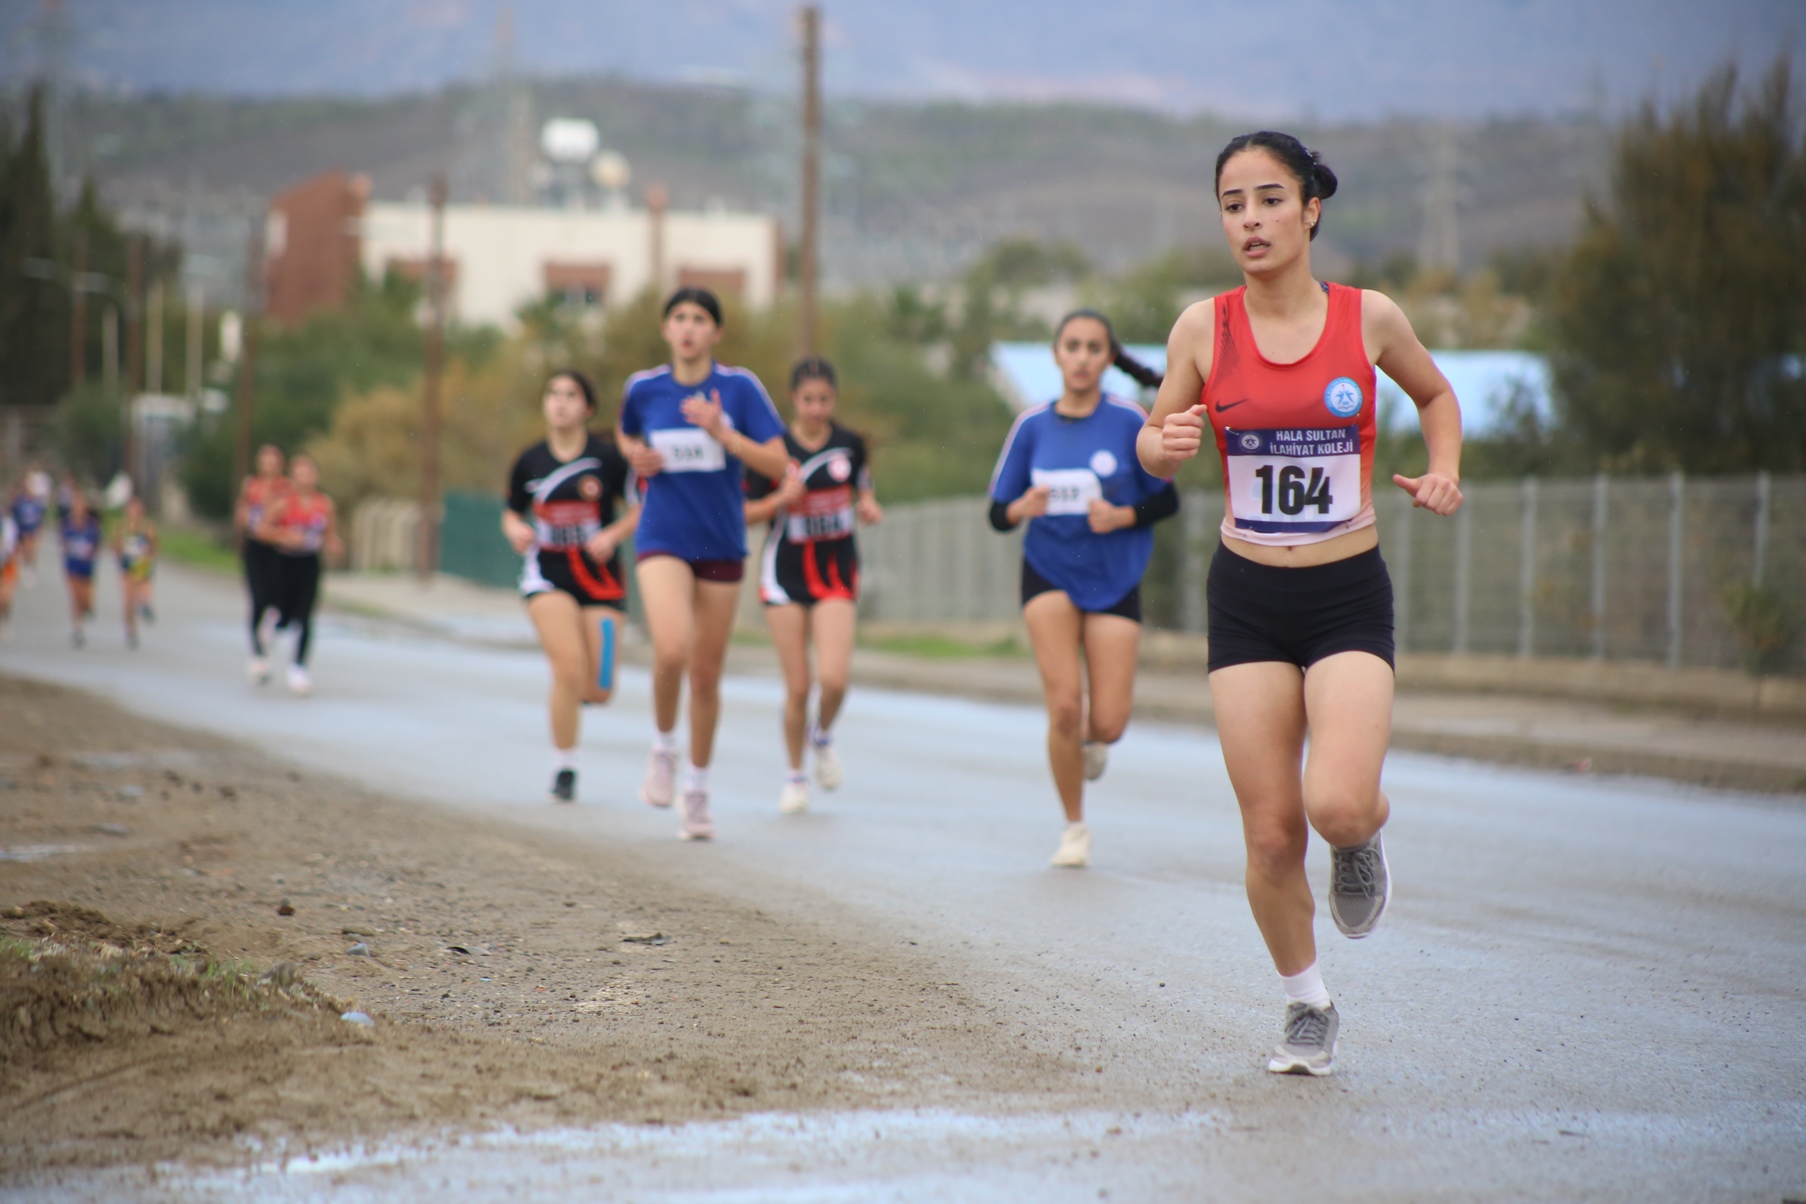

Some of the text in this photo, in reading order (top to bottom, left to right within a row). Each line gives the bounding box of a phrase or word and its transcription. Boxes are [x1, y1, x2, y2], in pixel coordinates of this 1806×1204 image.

[1276, 429, 1346, 442] HALA SULTAN
[1270, 439, 1354, 456] İLAHİYAT KOLEJİ
[1255, 464, 1333, 516] 164
